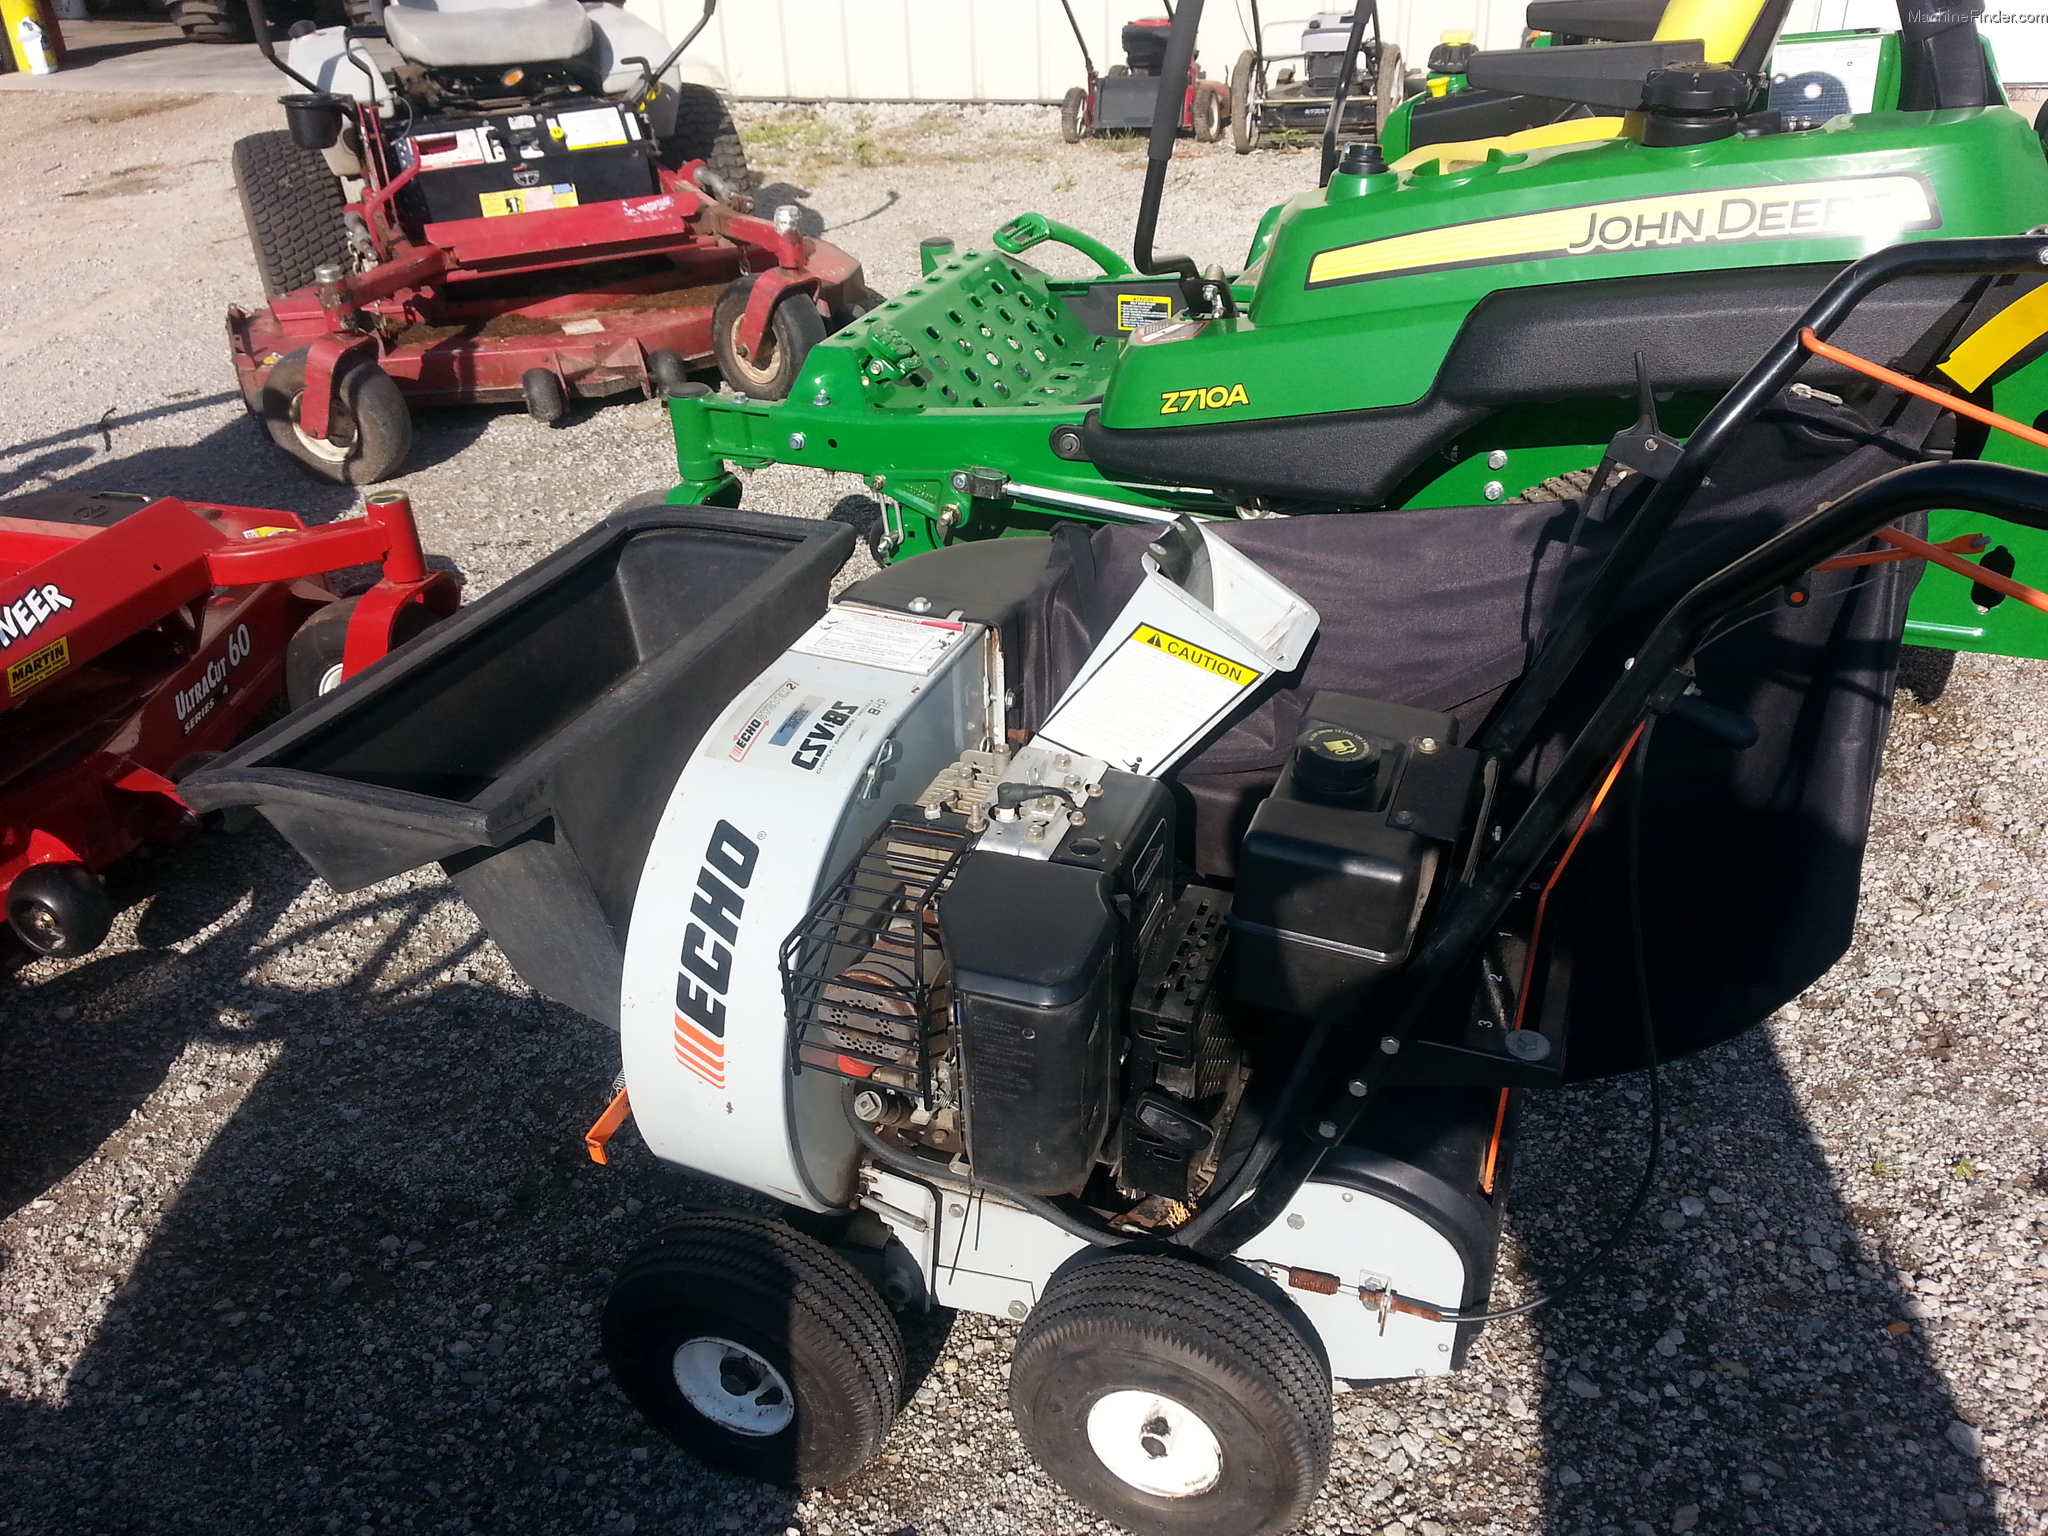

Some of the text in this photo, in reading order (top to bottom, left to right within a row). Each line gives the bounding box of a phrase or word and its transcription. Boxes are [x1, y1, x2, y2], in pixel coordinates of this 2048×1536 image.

[1569, 192, 1892, 250] JOHN DEER
[1160, 383, 1250, 415] Z710A
[12, 644, 65, 684] MARTIN
[228, 623, 251, 667] 60
[1167, 641, 1242, 682] CAUTION
[184, 697, 215, 735] SERIES
[736, 718, 762, 749] ECHO
[816, 748, 833, 775] CHIPPER
[834, 718, 855, 745] SHREDDER
[675, 818, 760, 1039] ECHO
[1488, 973, 1503, 982] 2
[1478, 1019, 1493, 1028] 3
